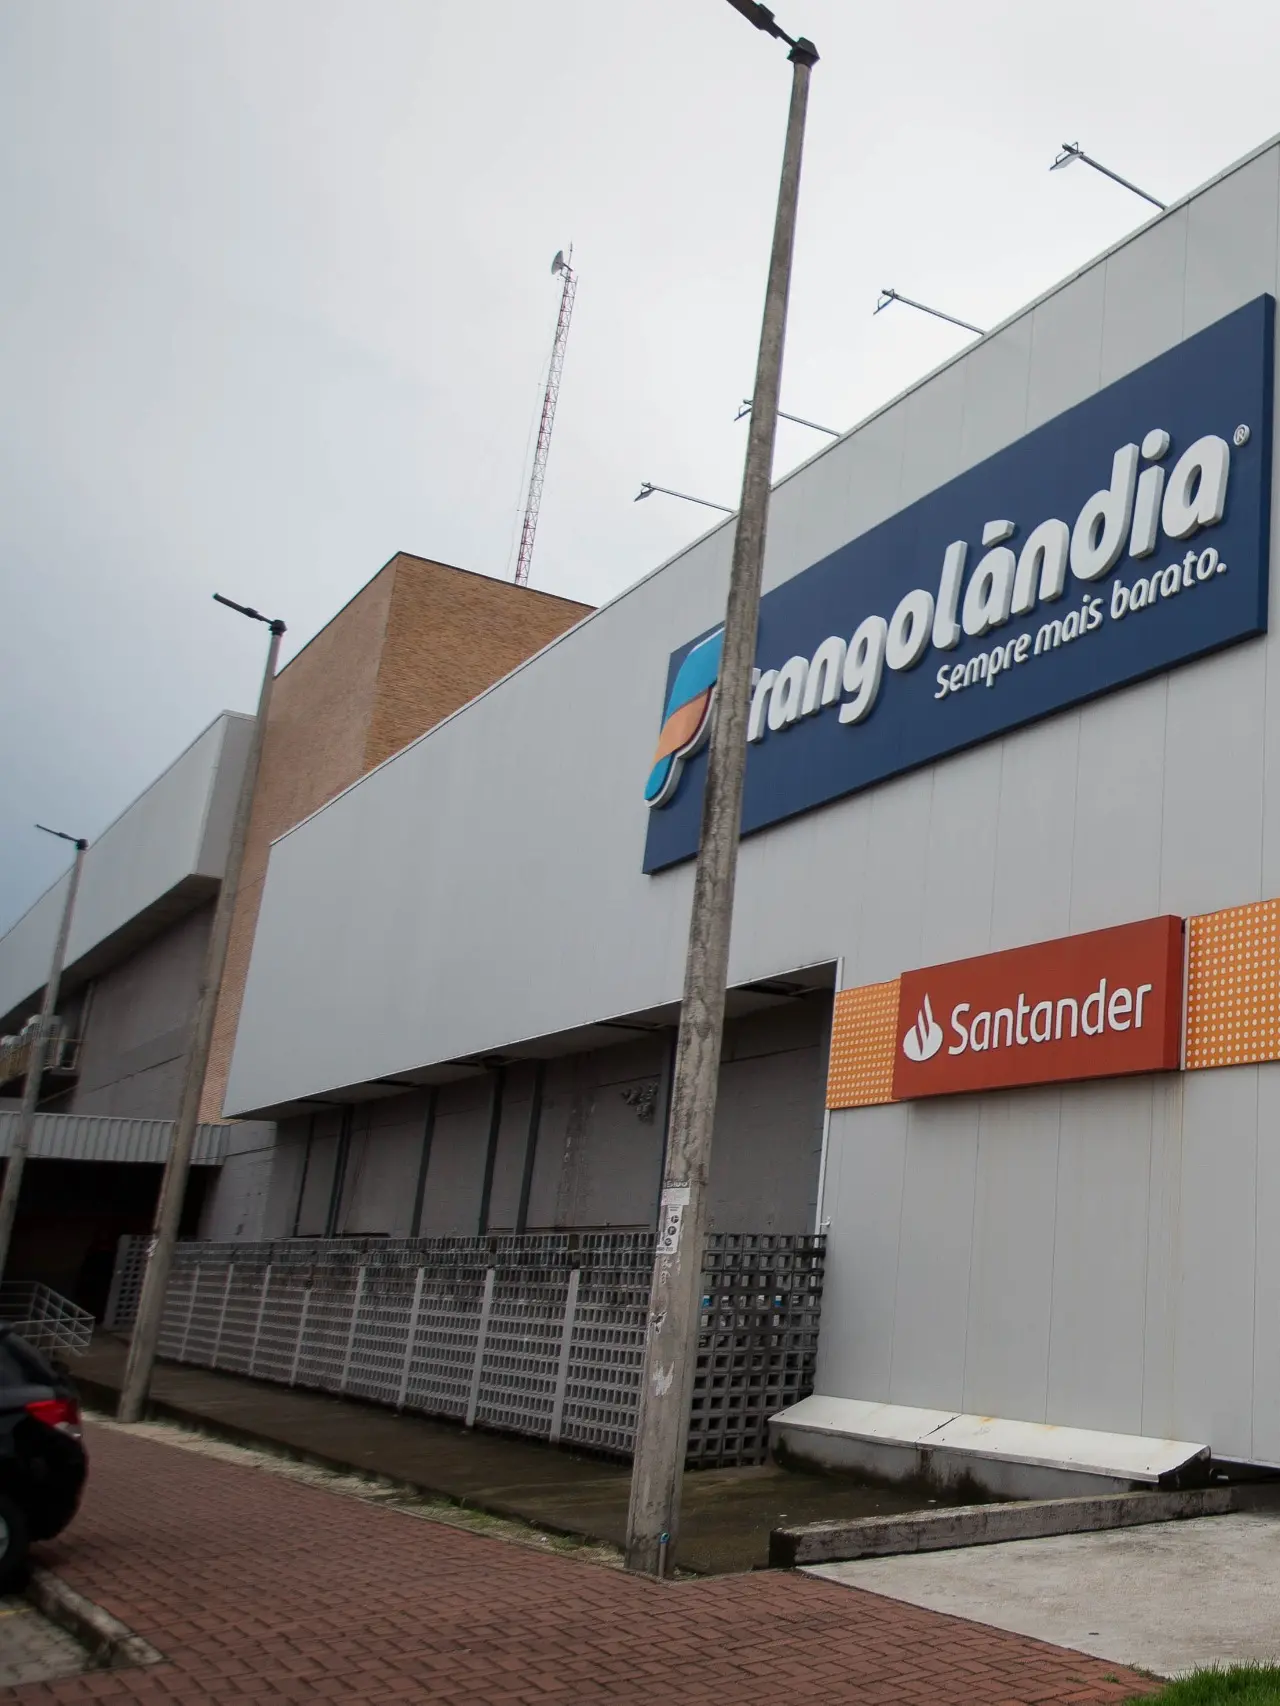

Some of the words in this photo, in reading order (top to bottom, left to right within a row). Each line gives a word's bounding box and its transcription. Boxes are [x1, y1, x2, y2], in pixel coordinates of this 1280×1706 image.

[934, 633, 1031, 699] Sempre
[1034, 594, 1103, 655] mais
[1110, 547, 1227, 620] barato.
[947, 977, 1153, 1056] Santander
